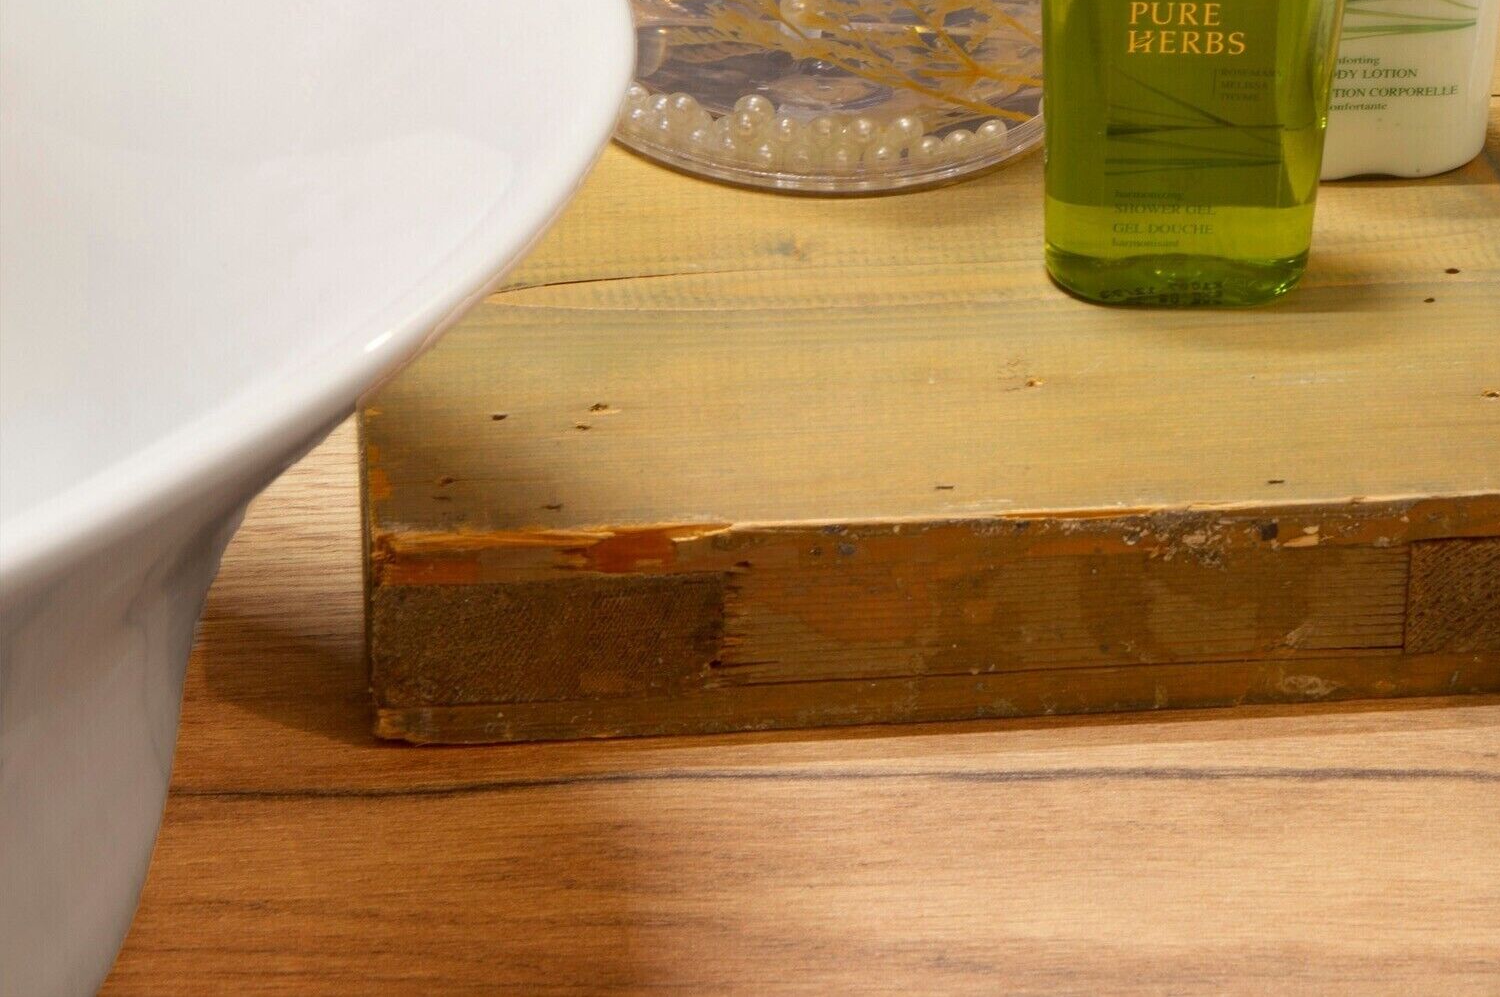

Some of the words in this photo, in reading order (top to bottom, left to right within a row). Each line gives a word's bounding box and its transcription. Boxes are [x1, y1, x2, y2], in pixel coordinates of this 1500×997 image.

[1128, 2, 1221, 26] PURE
[1127, 31, 1246, 55] HERBS
[1363, 69, 1418, 79] LOTION
[1333, 88, 1366, 98] TION
[1369, 85, 1459, 98] CORPORELLE
[1329, 103, 1388, 111] onfortante
[1114, 203, 1181, 214] SHOWER
[1185, 203, 1216, 215] GEL
[1112, 224, 1143, 234] GEL
[1148, 224, 1214, 234] DOUCHE
